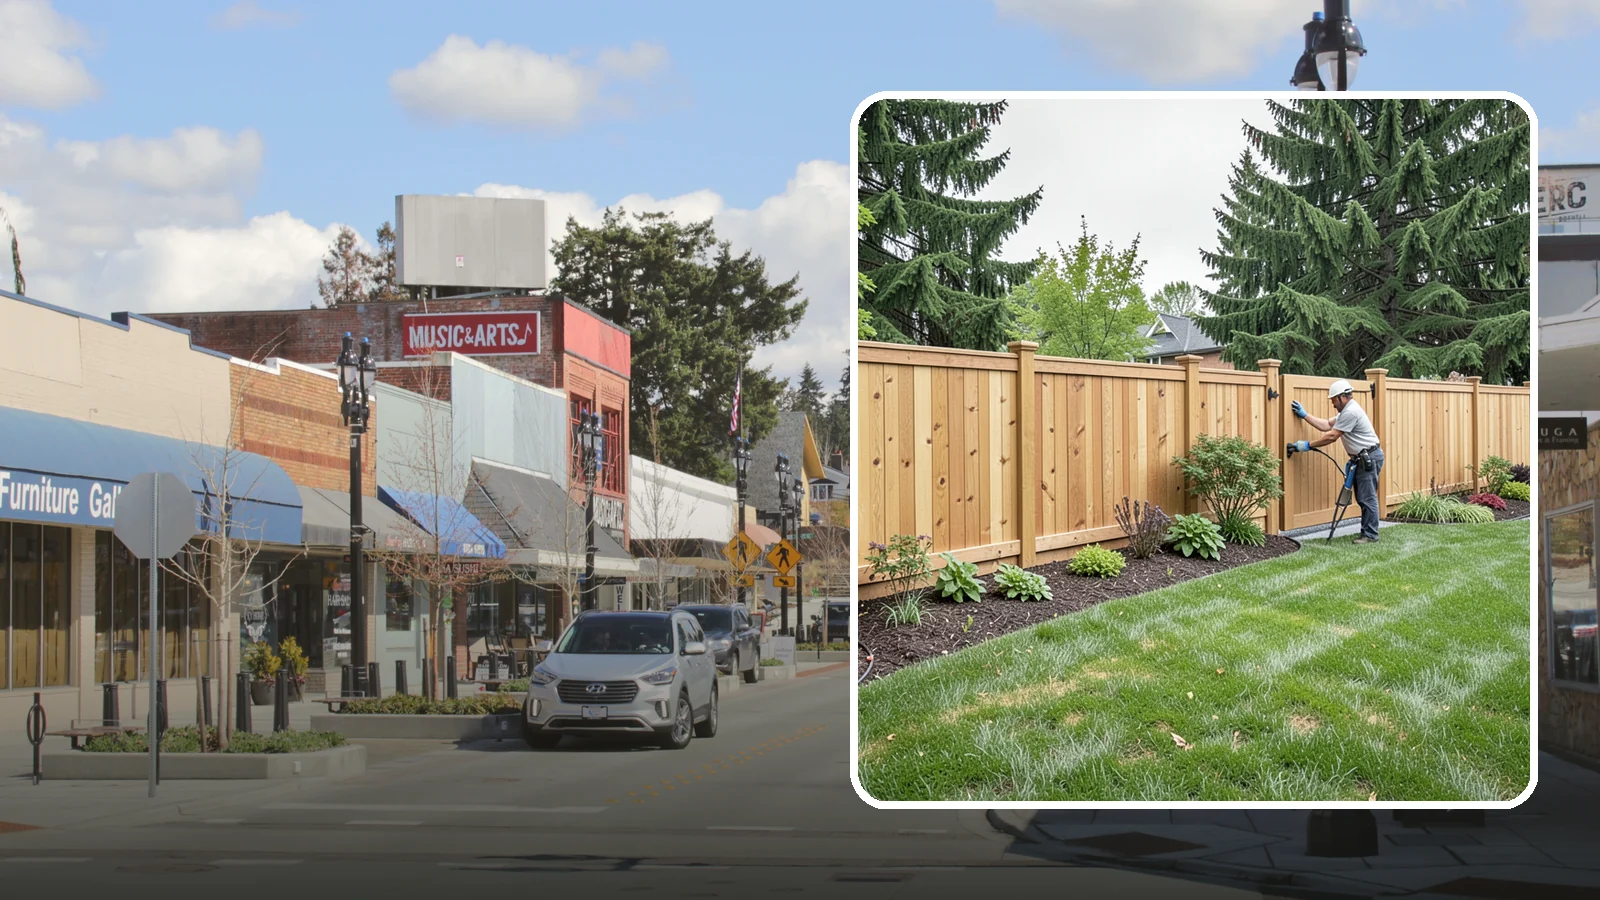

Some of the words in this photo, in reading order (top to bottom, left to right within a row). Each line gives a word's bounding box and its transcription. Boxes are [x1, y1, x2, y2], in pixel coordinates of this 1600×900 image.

[1540, 427, 1578, 437] UGA
[0, 471, 80, 515] Furniture
[89, 482, 121, 519] Gal
